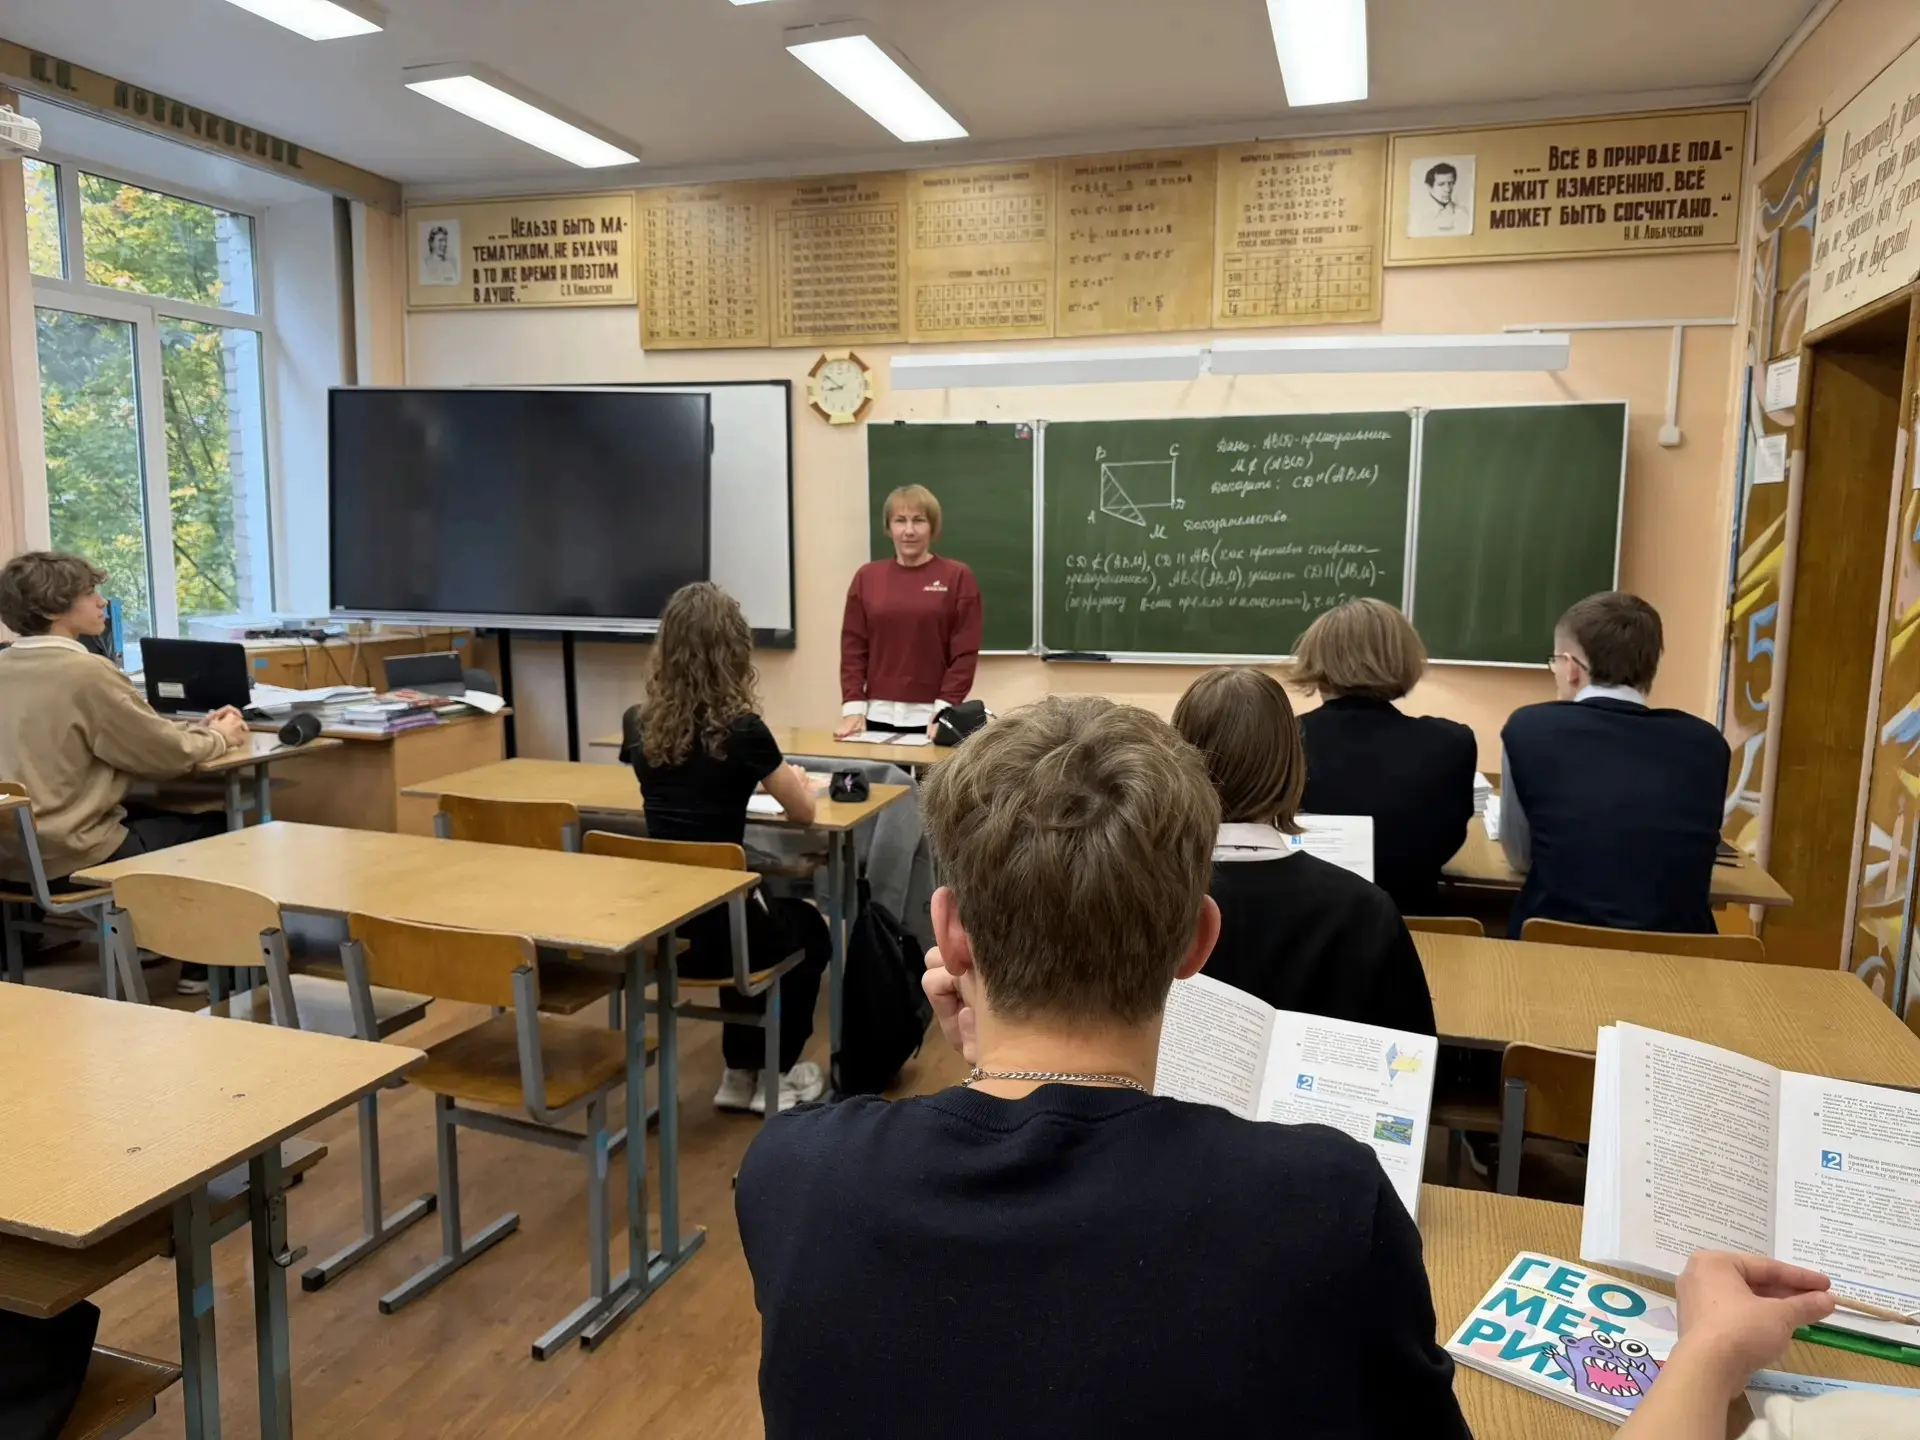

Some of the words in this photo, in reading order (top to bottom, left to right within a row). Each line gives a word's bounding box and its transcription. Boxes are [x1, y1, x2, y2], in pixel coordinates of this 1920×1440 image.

[1587, 149, 1597, 168] В
[1603, 142, 1681, 167] ПРИРОДЕ
[1688, 140, 1734, 162] ПОД-
[1490, 179, 1549, 203] ЛЕЖИТ
[1674, 166, 1706, 191] ВСЁ
[563, 219, 595, 235] БЫТЬ
[1490, 207, 1552, 229] МОЖЕТ
[1560, 204, 1606, 225] БЫТЬ
[1644, 224, 1704, 239] ЛОБАЧЕВСКИЙ
[554, 243, 568, 260] НЕ
[573, 240, 618, 257] БУДУЧИ
[473, 268, 480, 284] В
[484, 268, 497, 284] ТО
[501, 267, 517, 283] ЖЕ
[521, 265, 557, 283] ВРЕМЯ
[561, 265, 567, 281] И
[570, 263, 618, 281] ПОЭТОМ
[474, 287, 480, 303] В
[1508, 1257, 1647, 1318] ГЕО
[1481, 1287, 1627, 1337] МЕТ
[1457, 1317, 1576, 1383] РИ
